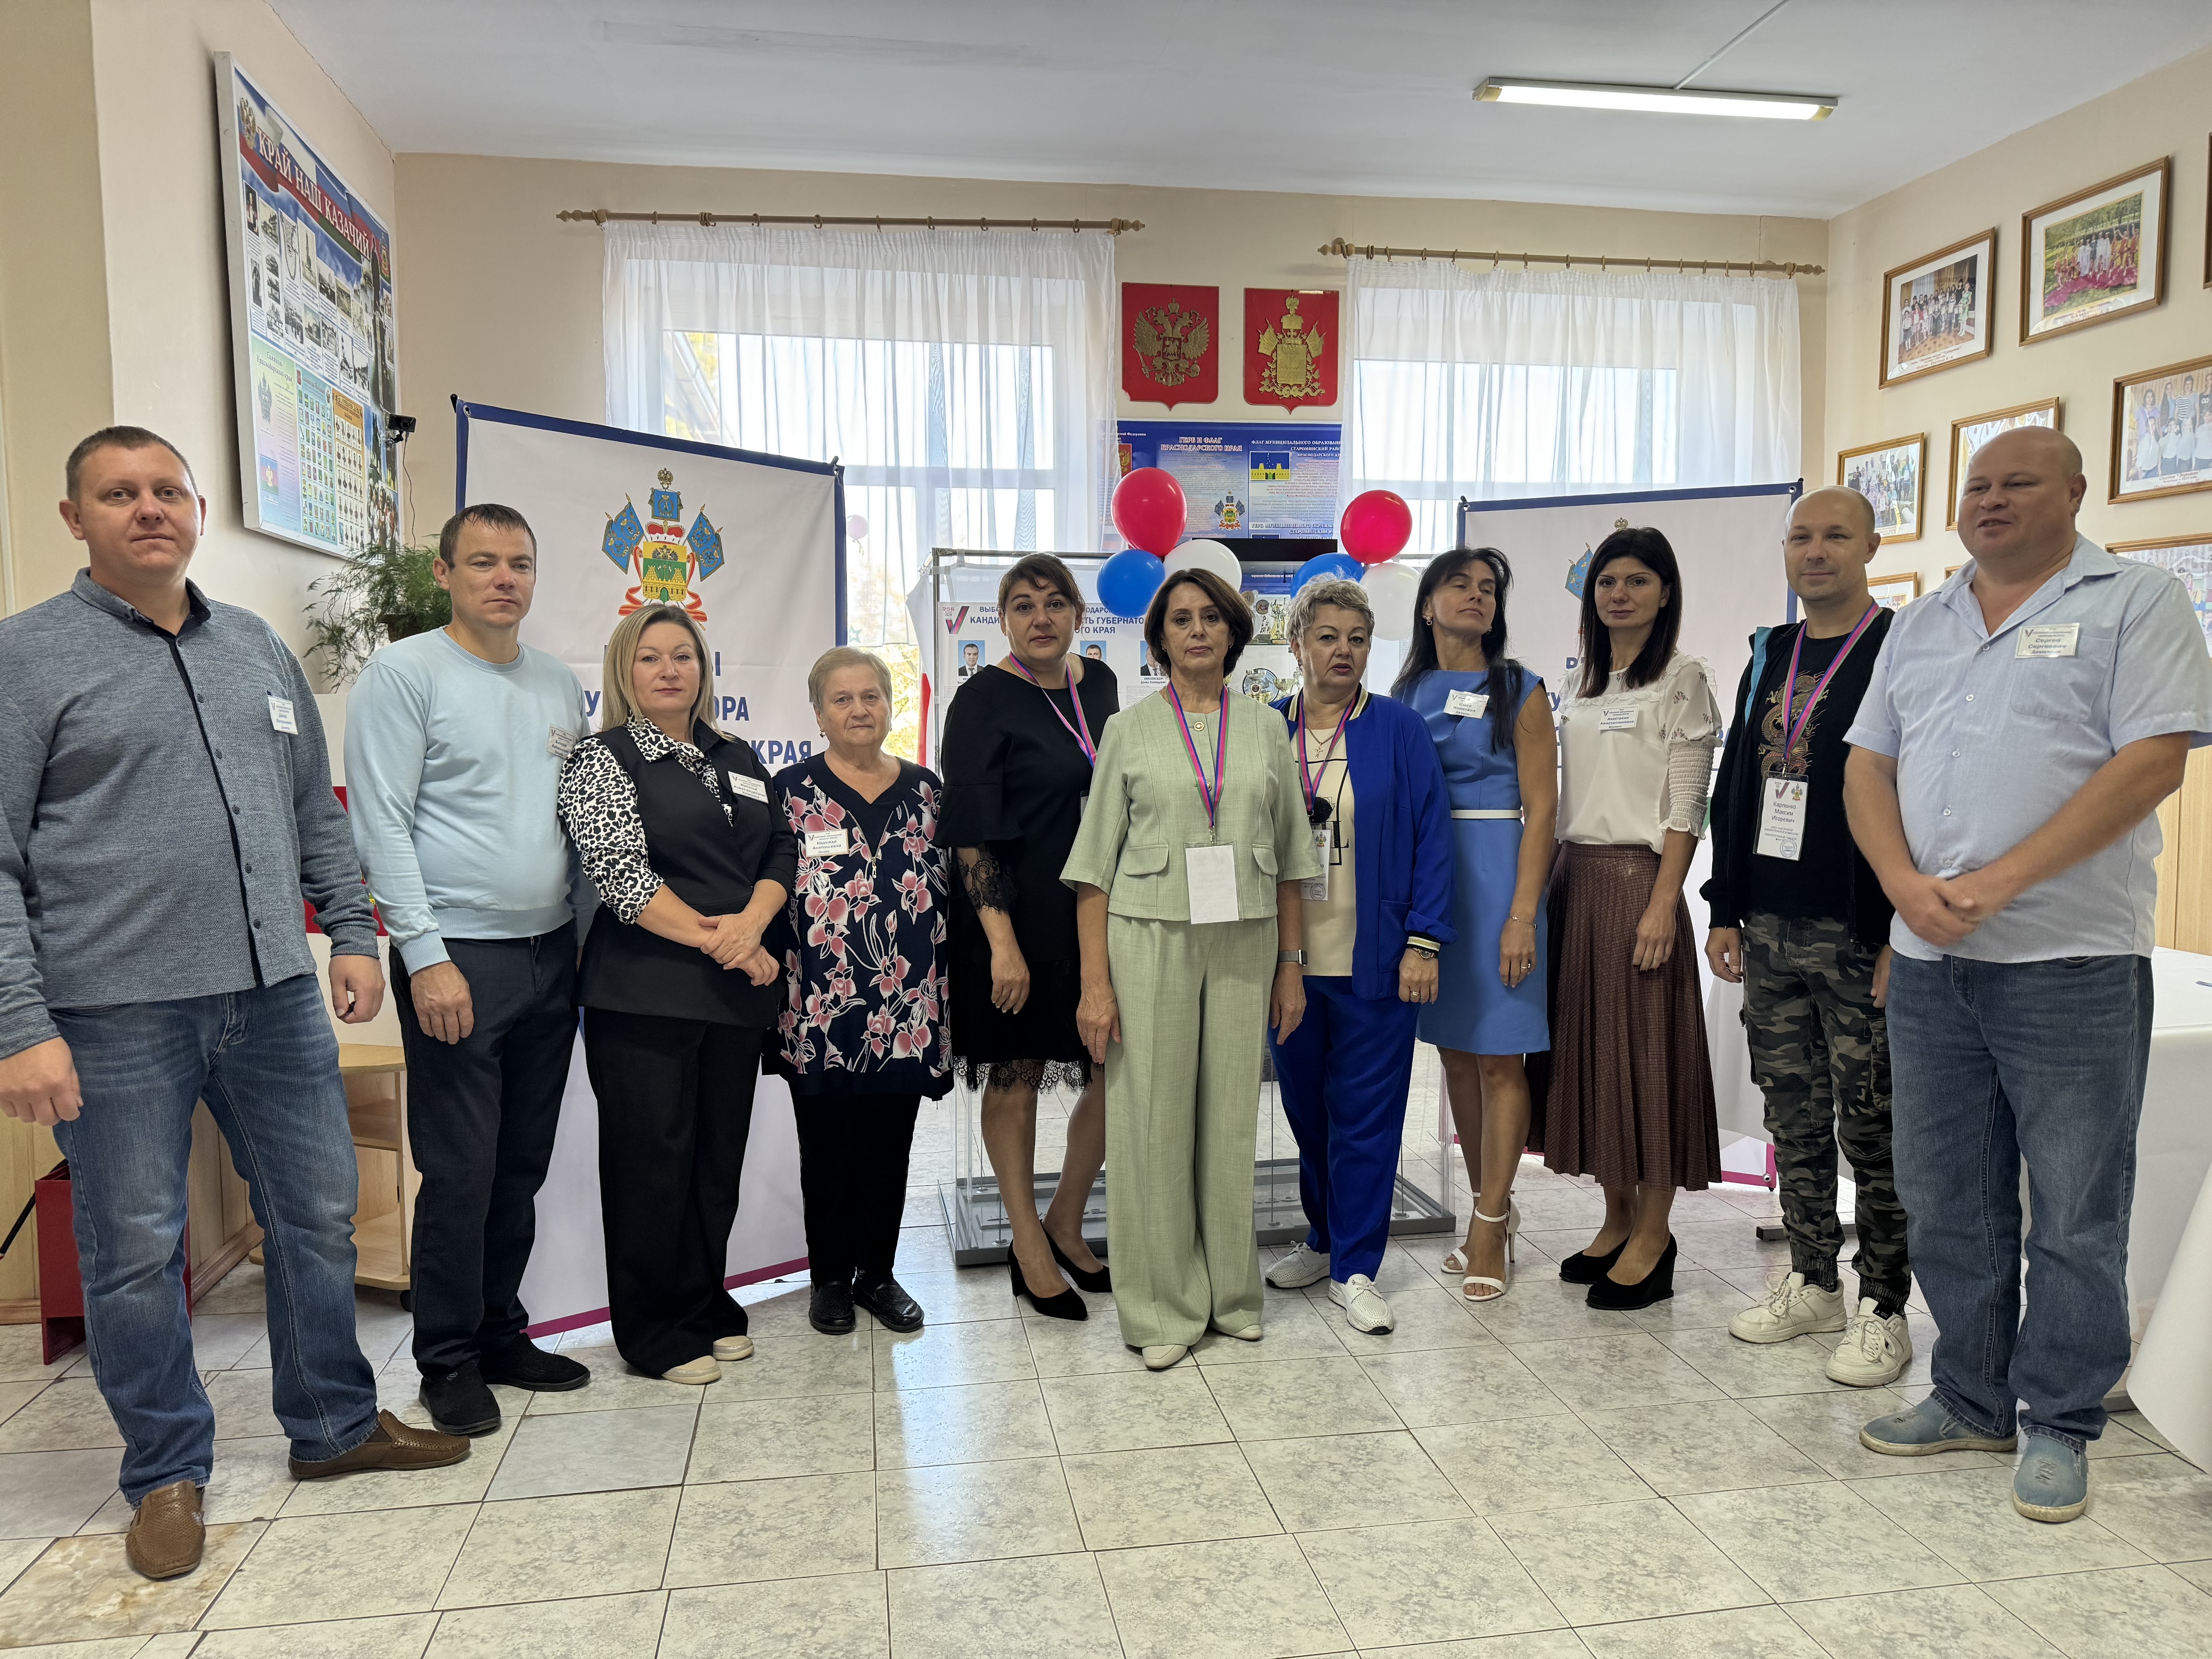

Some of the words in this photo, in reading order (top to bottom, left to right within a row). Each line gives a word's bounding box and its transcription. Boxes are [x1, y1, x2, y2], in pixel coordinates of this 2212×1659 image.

[257, 126, 292, 184] КРАЙ
[295, 165, 322, 213] НАШ
[324, 196, 370, 260] КАЗАЧИЙ
[751, 740, 811, 764] КРАЯ
